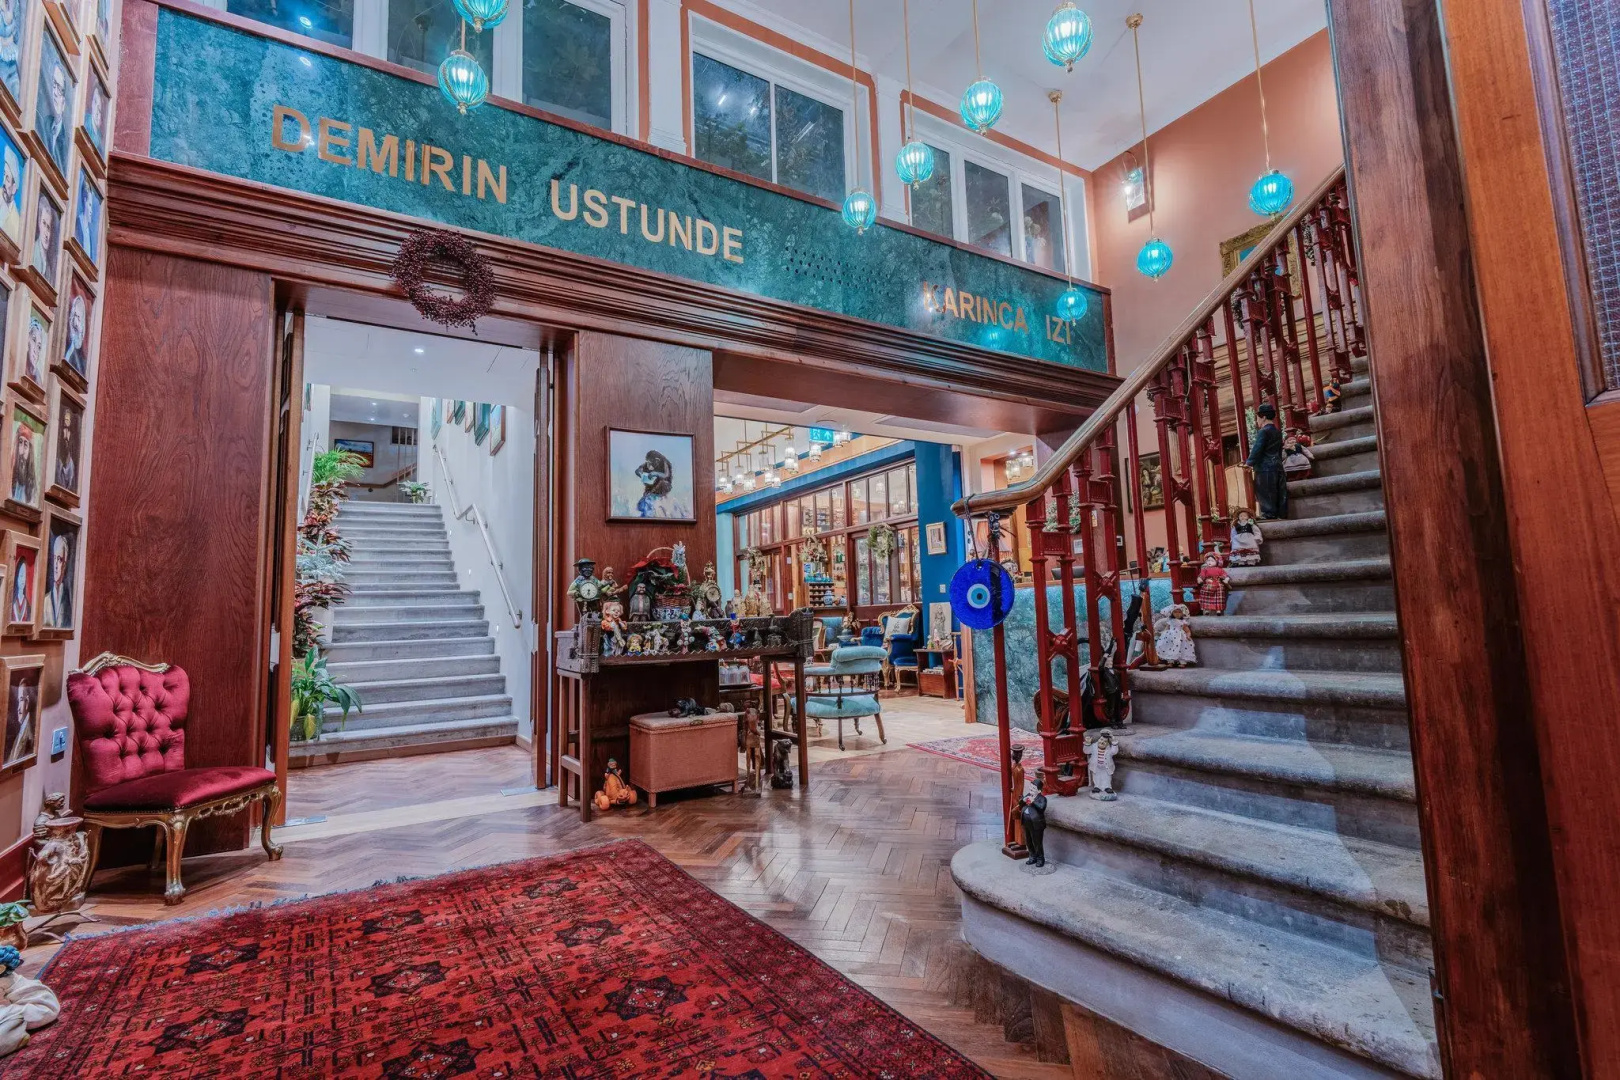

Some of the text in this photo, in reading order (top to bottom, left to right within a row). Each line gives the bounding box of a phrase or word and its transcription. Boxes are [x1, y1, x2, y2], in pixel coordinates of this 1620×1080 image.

[272, 104, 1071, 345] DEMIRIN USTUNDE KARINCA IZI
